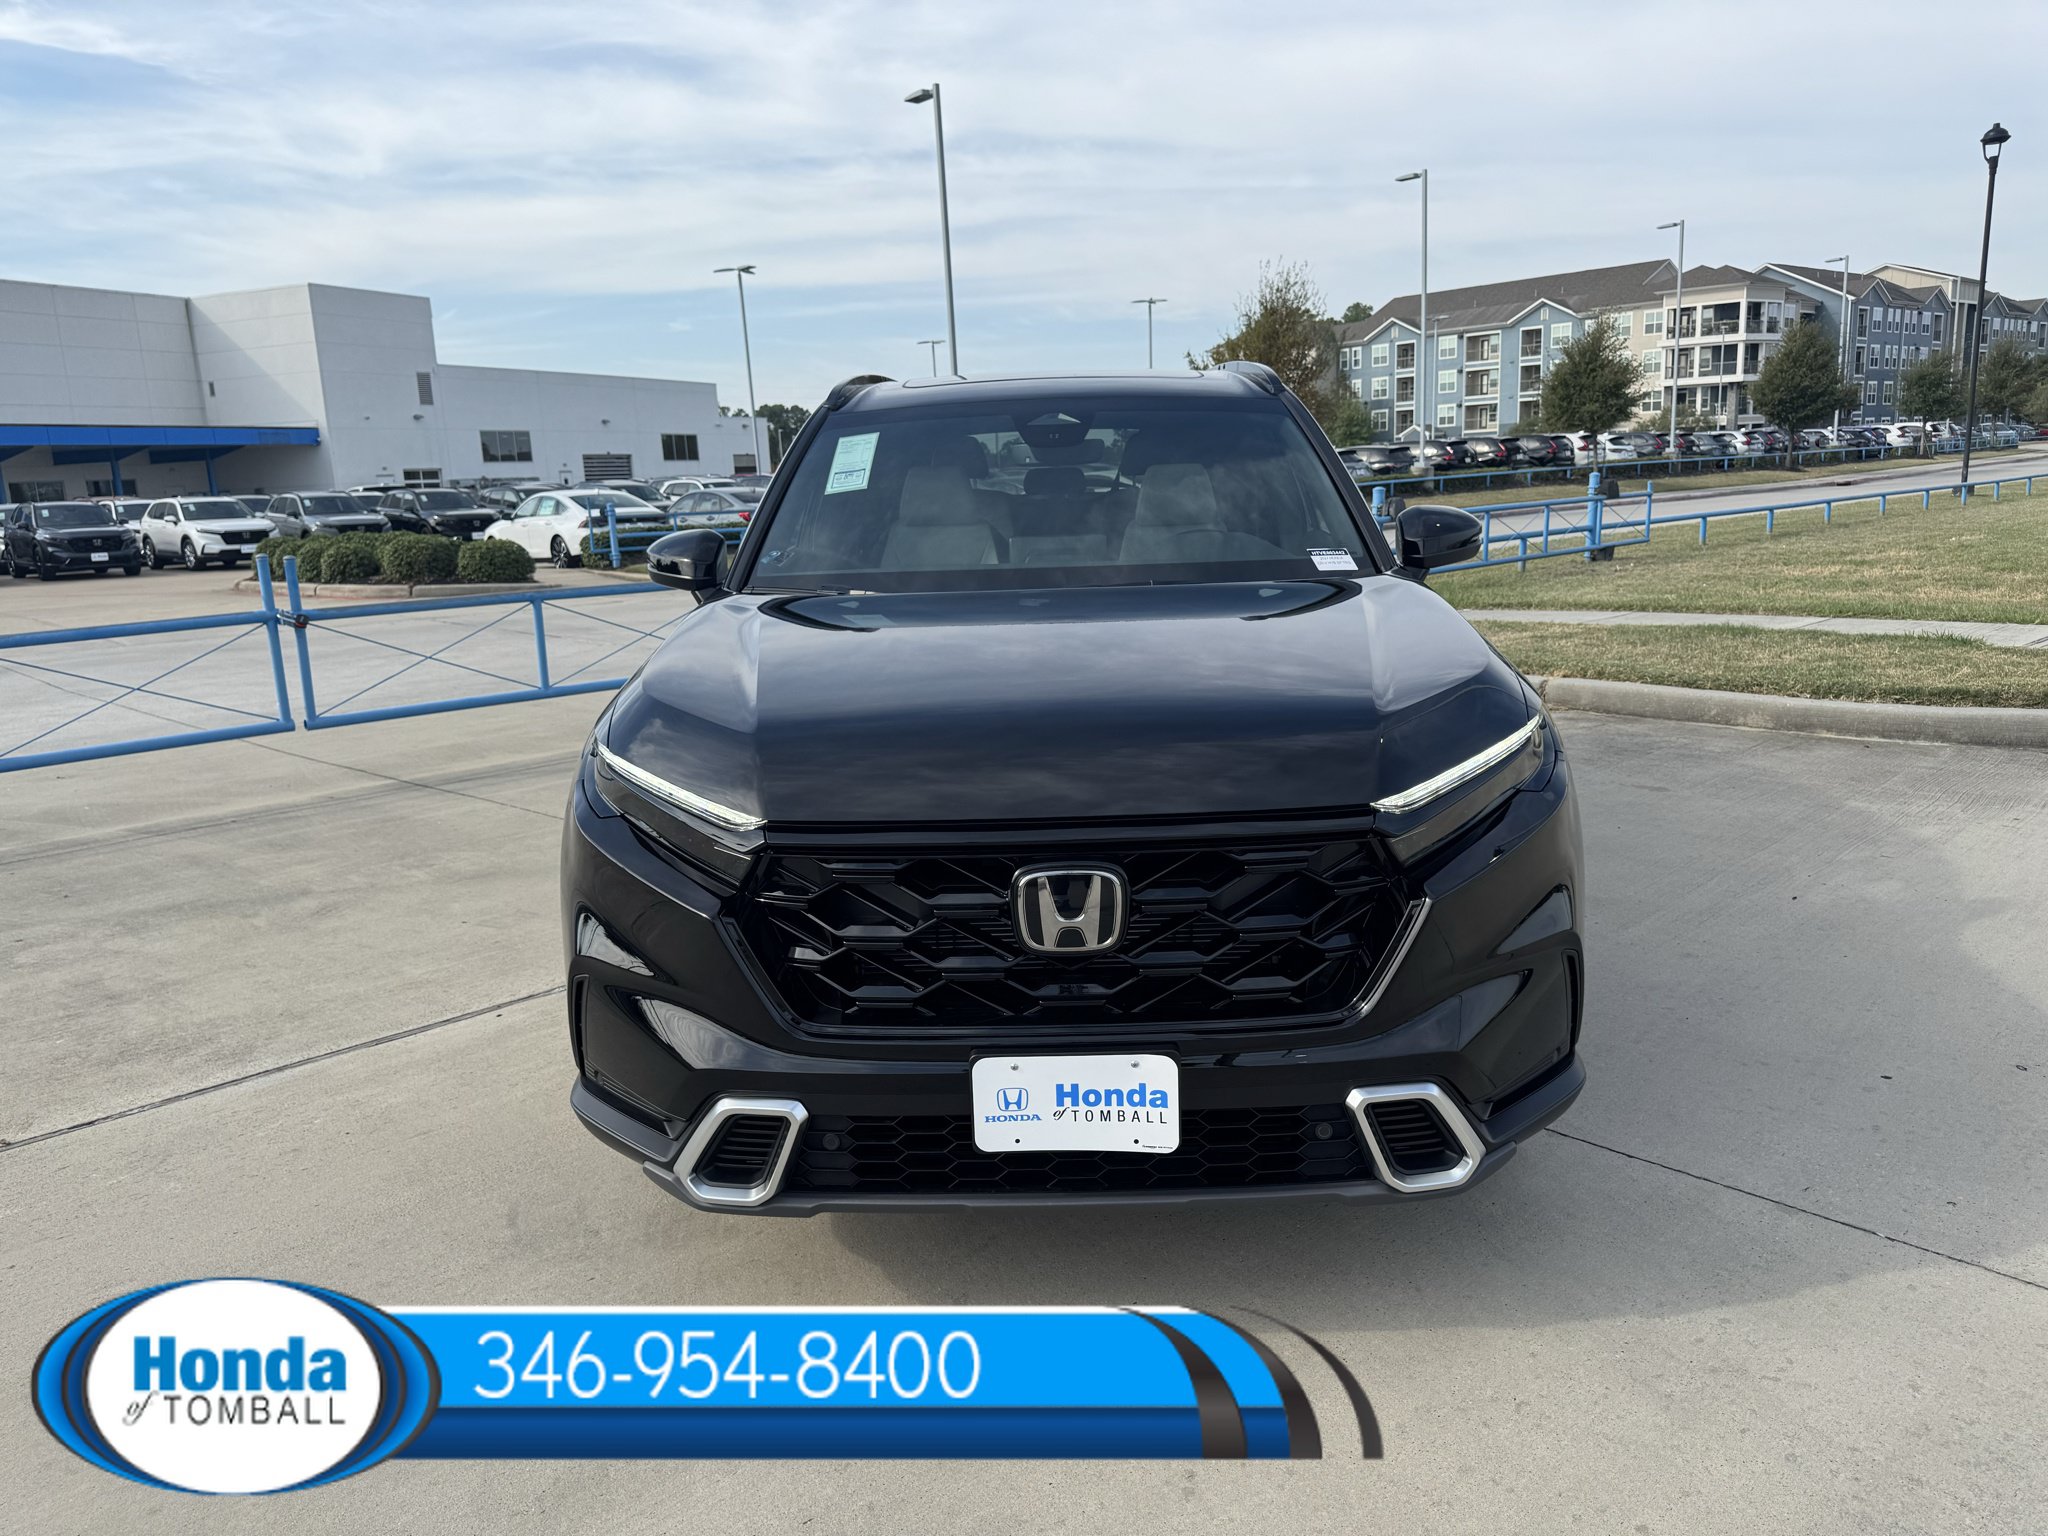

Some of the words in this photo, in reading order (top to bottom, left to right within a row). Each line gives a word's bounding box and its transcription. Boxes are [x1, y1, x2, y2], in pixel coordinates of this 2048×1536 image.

[1055, 1083, 1169, 1109] Honda
[984, 1113, 1043, 1123] HONDA
[1052, 1106, 1070, 1121] of
[1071, 1109, 1168, 1125] TOMBALL
